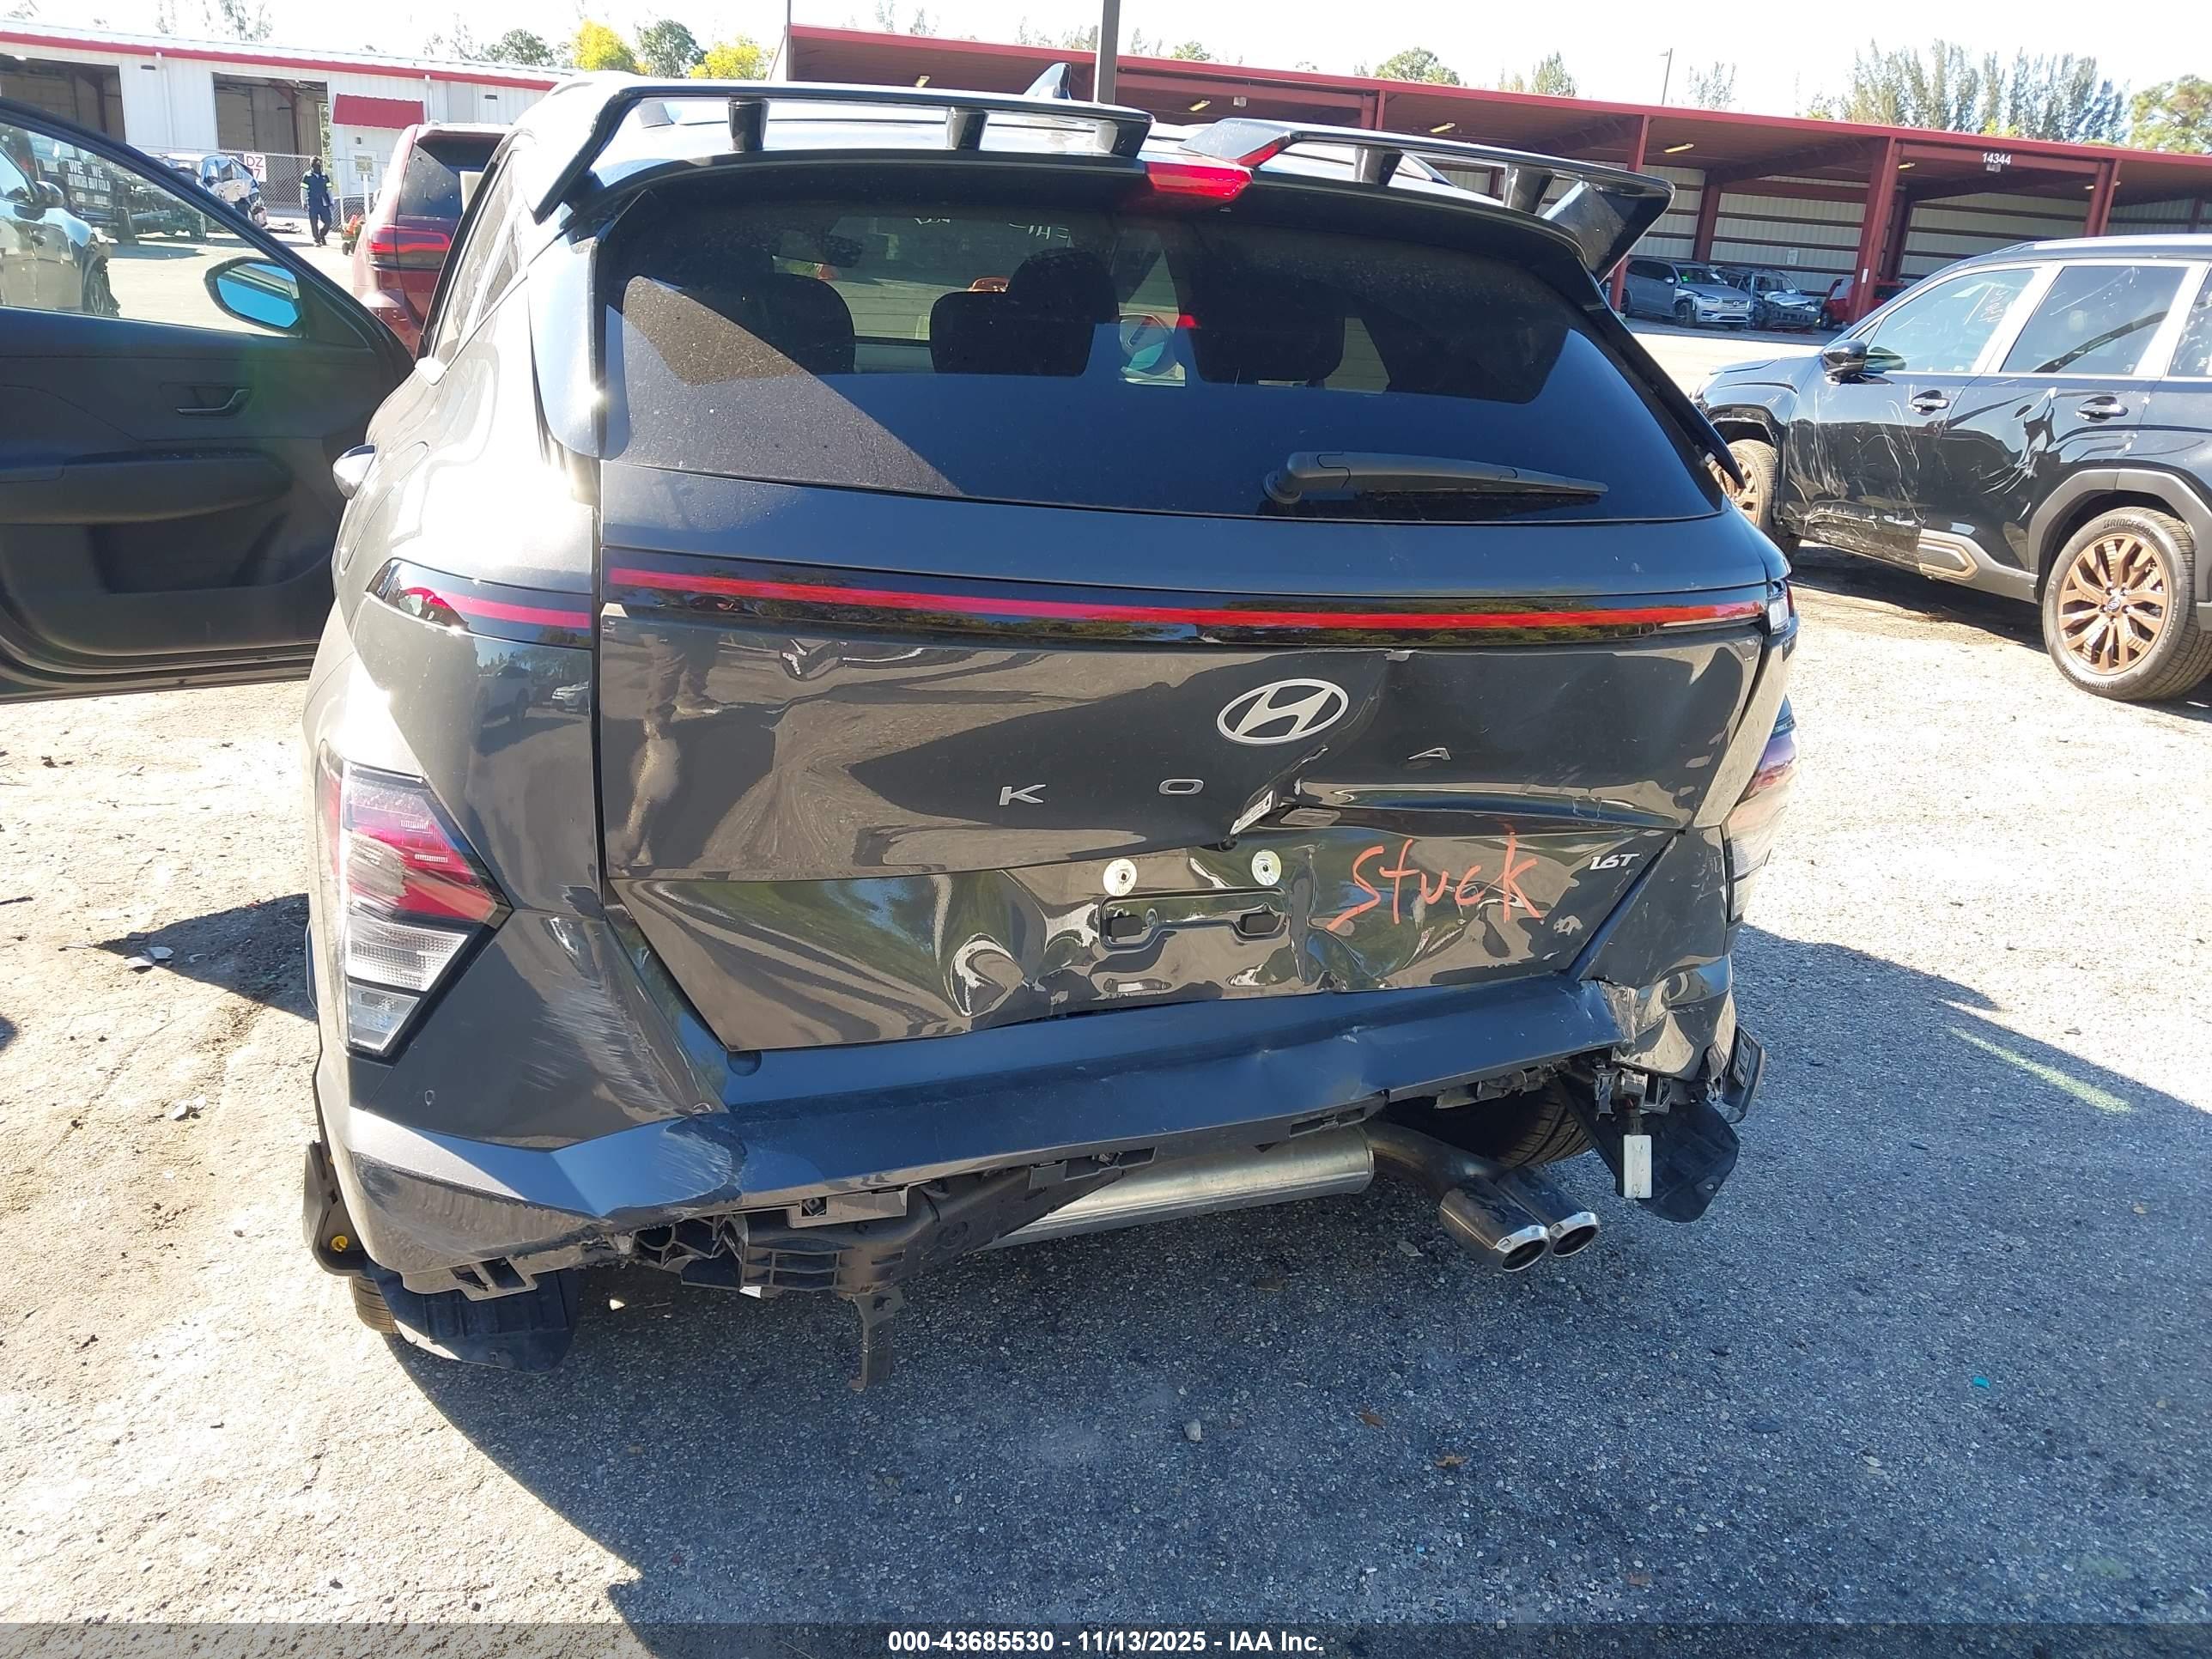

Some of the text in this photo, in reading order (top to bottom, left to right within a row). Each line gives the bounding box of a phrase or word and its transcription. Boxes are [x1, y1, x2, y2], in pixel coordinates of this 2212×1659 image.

[246, 155, 264, 168] DZ
[1982, 152, 2012, 165] 14344
[68, 160, 84, 175] WE
[90, 164, 104, 179] WE
